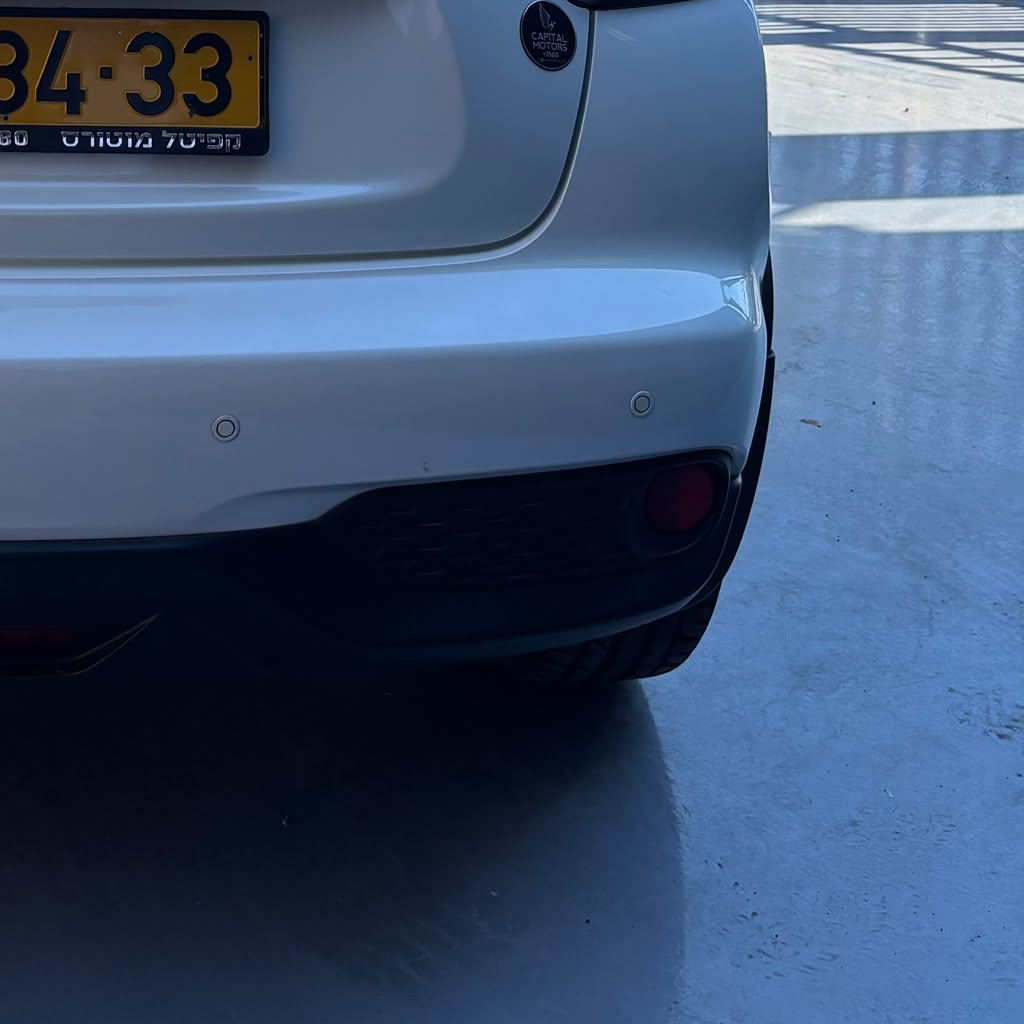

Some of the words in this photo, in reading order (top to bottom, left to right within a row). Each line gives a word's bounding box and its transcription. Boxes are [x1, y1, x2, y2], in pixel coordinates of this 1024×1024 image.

[531, 31, 568, 43] CAPITAL
[532, 41, 568, 52] MOTORS
[60, 130, 153, 148] מוטורס
[161, 129, 242, 153] קפיטל
